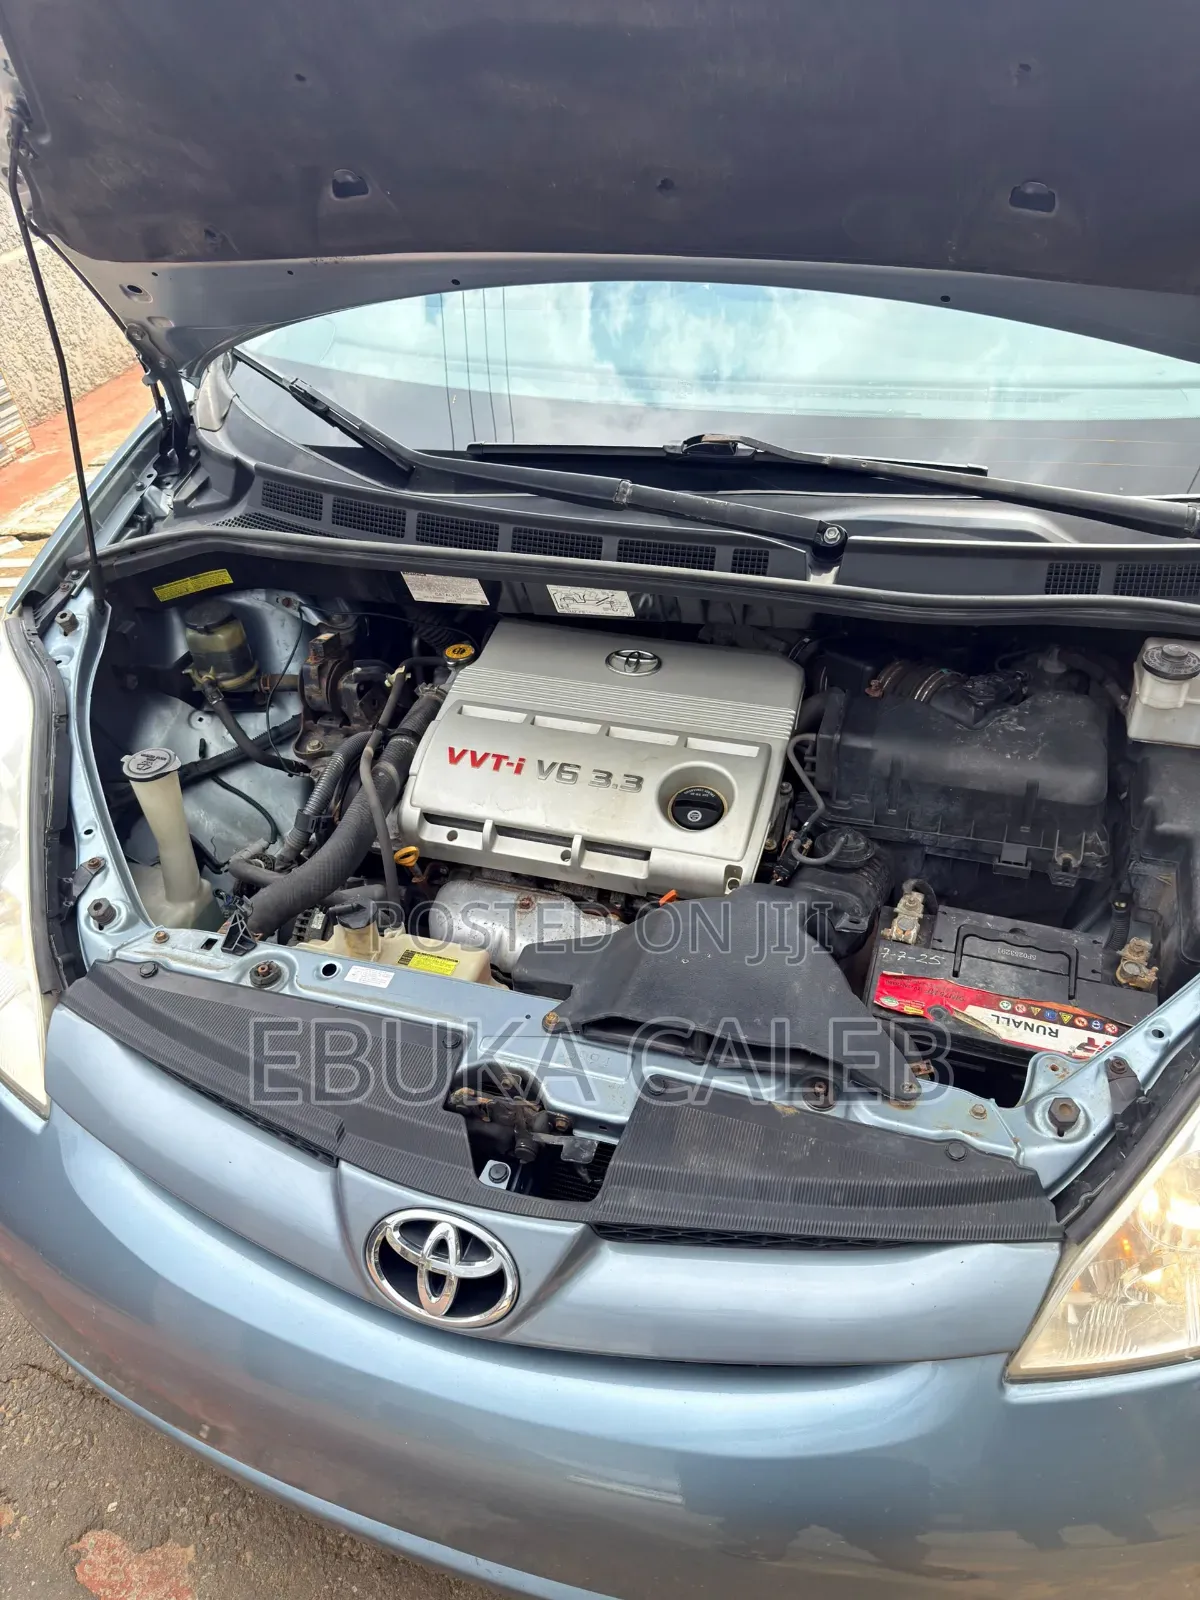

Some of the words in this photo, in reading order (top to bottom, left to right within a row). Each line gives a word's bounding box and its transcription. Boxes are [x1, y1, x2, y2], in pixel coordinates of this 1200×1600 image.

[447, 746, 526, 775] VVT-i
[537, 759, 581, 785] V6
[588, 768, 645, 794] 3.3
[880, 947, 945, 965] 7-7-25
[991, 1013, 1059, 1039] RUNALL
